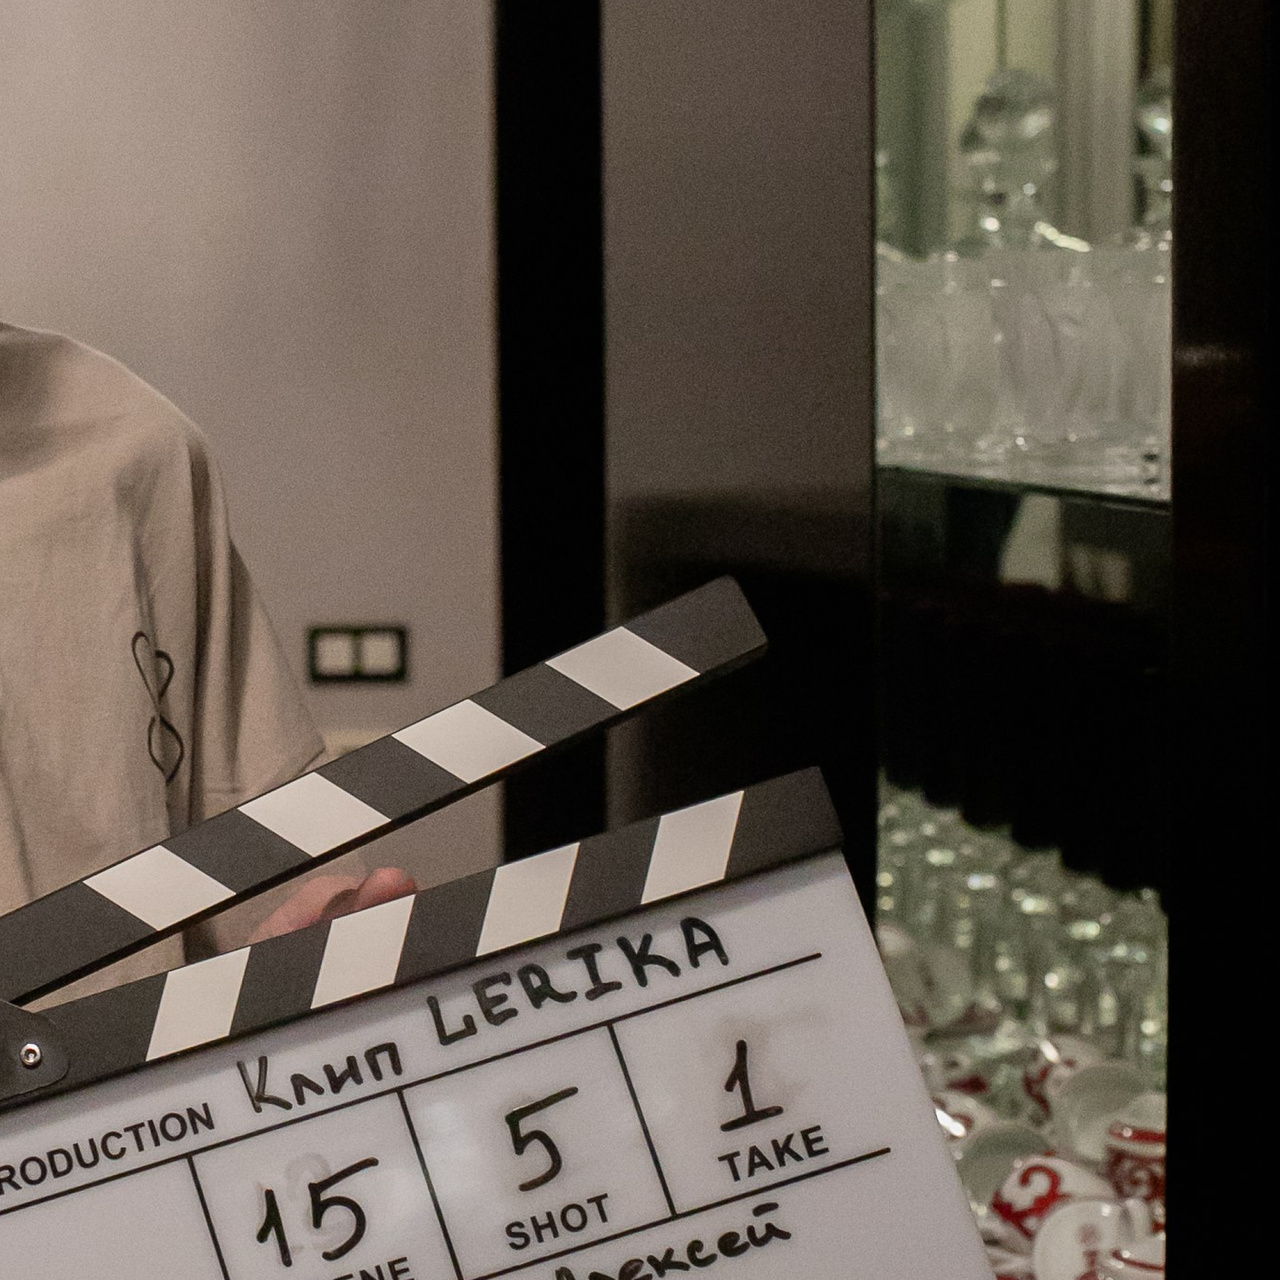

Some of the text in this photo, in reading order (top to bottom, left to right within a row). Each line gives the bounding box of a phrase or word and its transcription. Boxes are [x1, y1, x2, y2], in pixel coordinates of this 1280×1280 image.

[426, 916, 729, 1046] LERIKA
[720, 1040, 784, 1132] 1
[505, 1087, 578, 1192] 5
[718, 1125, 829, 1182] TAKE
[256, 1157, 379, 1267] 15
[505, 1193, 608, 1250] SHOT
